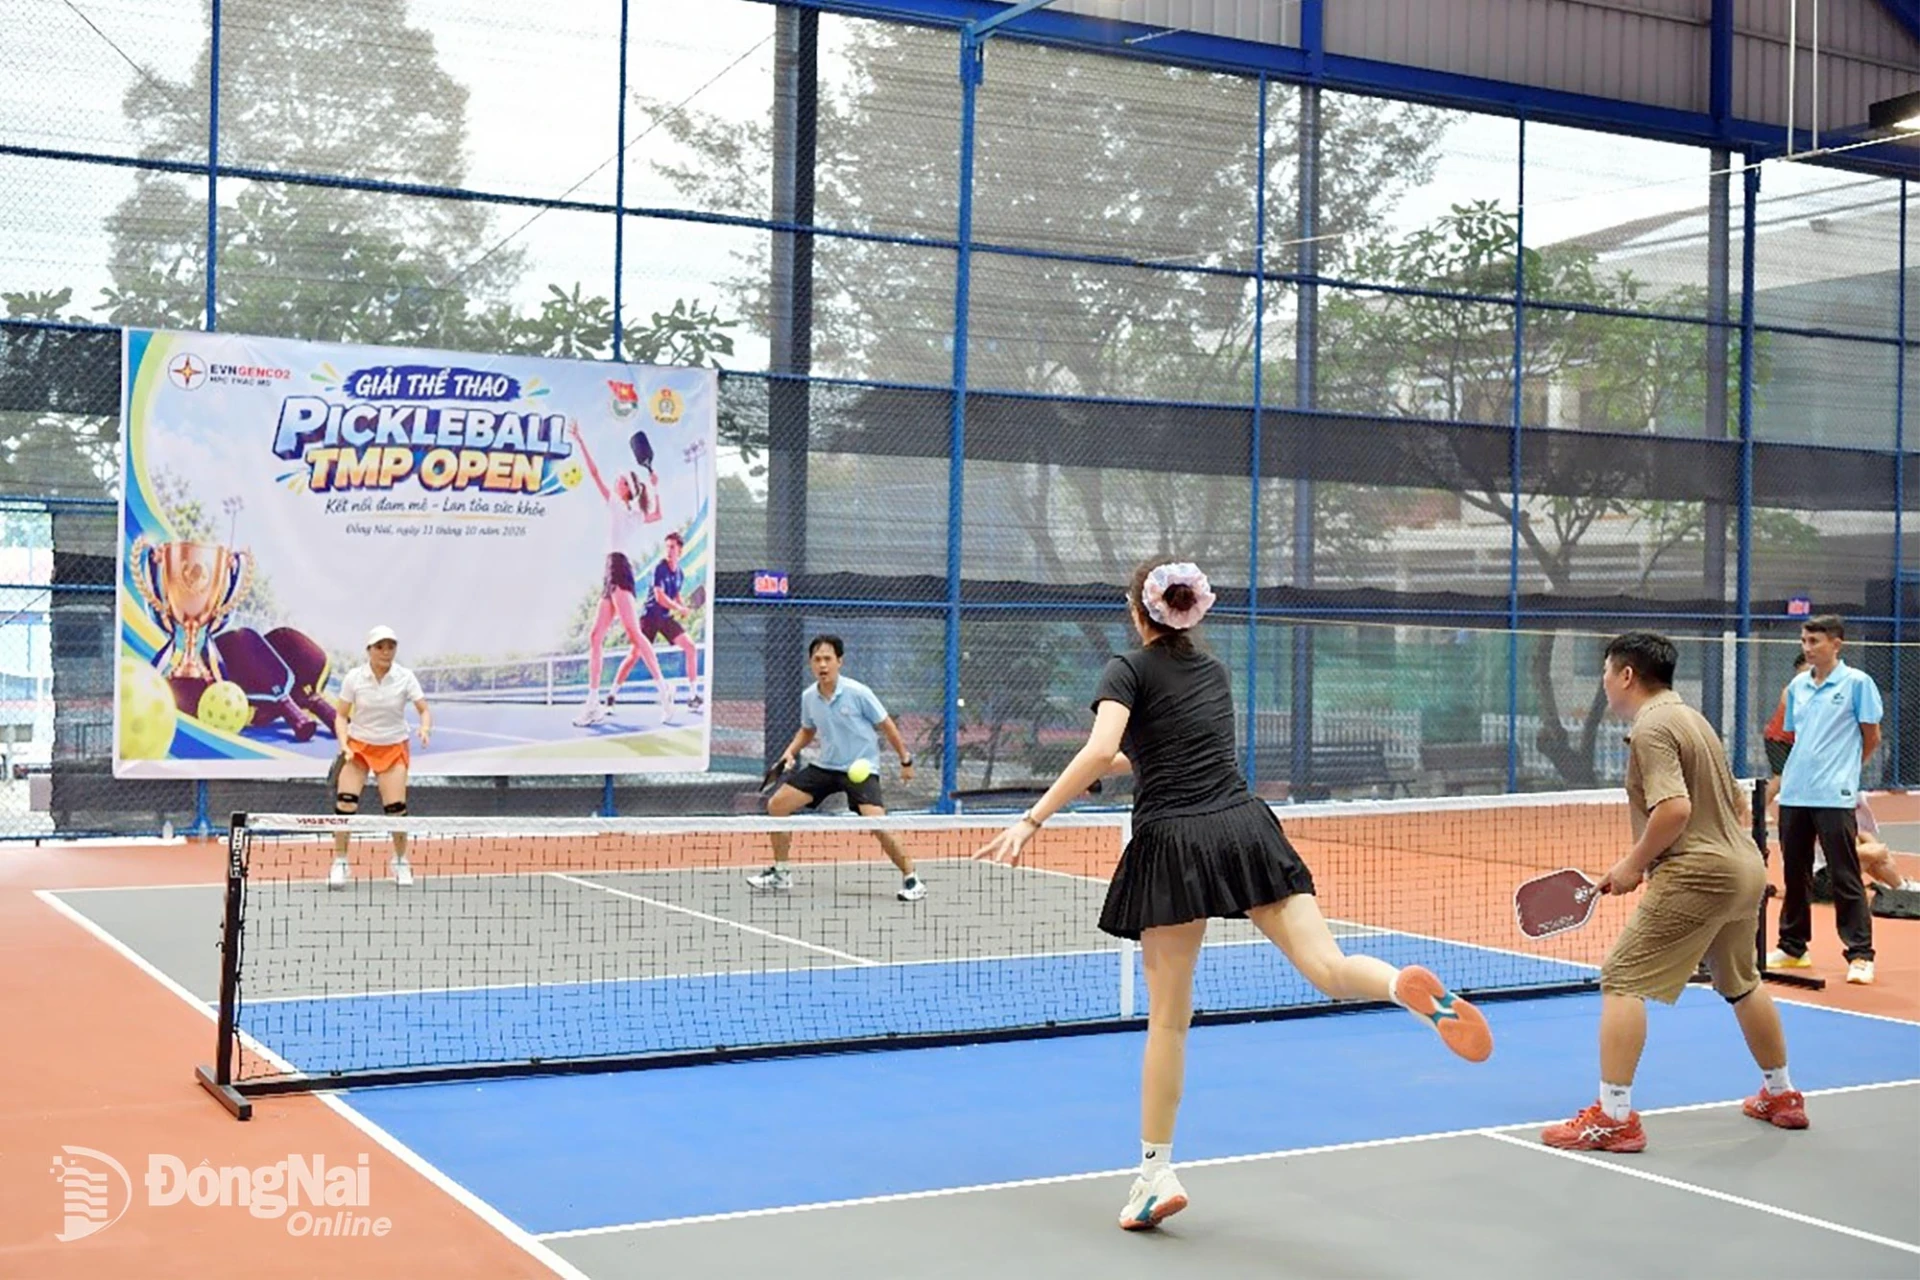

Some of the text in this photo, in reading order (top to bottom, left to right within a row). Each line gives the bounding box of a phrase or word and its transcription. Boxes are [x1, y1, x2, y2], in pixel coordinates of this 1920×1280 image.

[210, 364, 291, 379] EVNGENCO2
[355, 368, 399, 396] GIẢI
[453, 375, 508, 397] THAO
[273, 395, 573, 460] PICKLEBALL
[306, 447, 545, 493] TMP OPEN
[376, 496, 405, 512] đam
[408, 498, 428, 512] mê
[442, 496, 466, 511] Lan
[493, 499, 514, 513] sức
